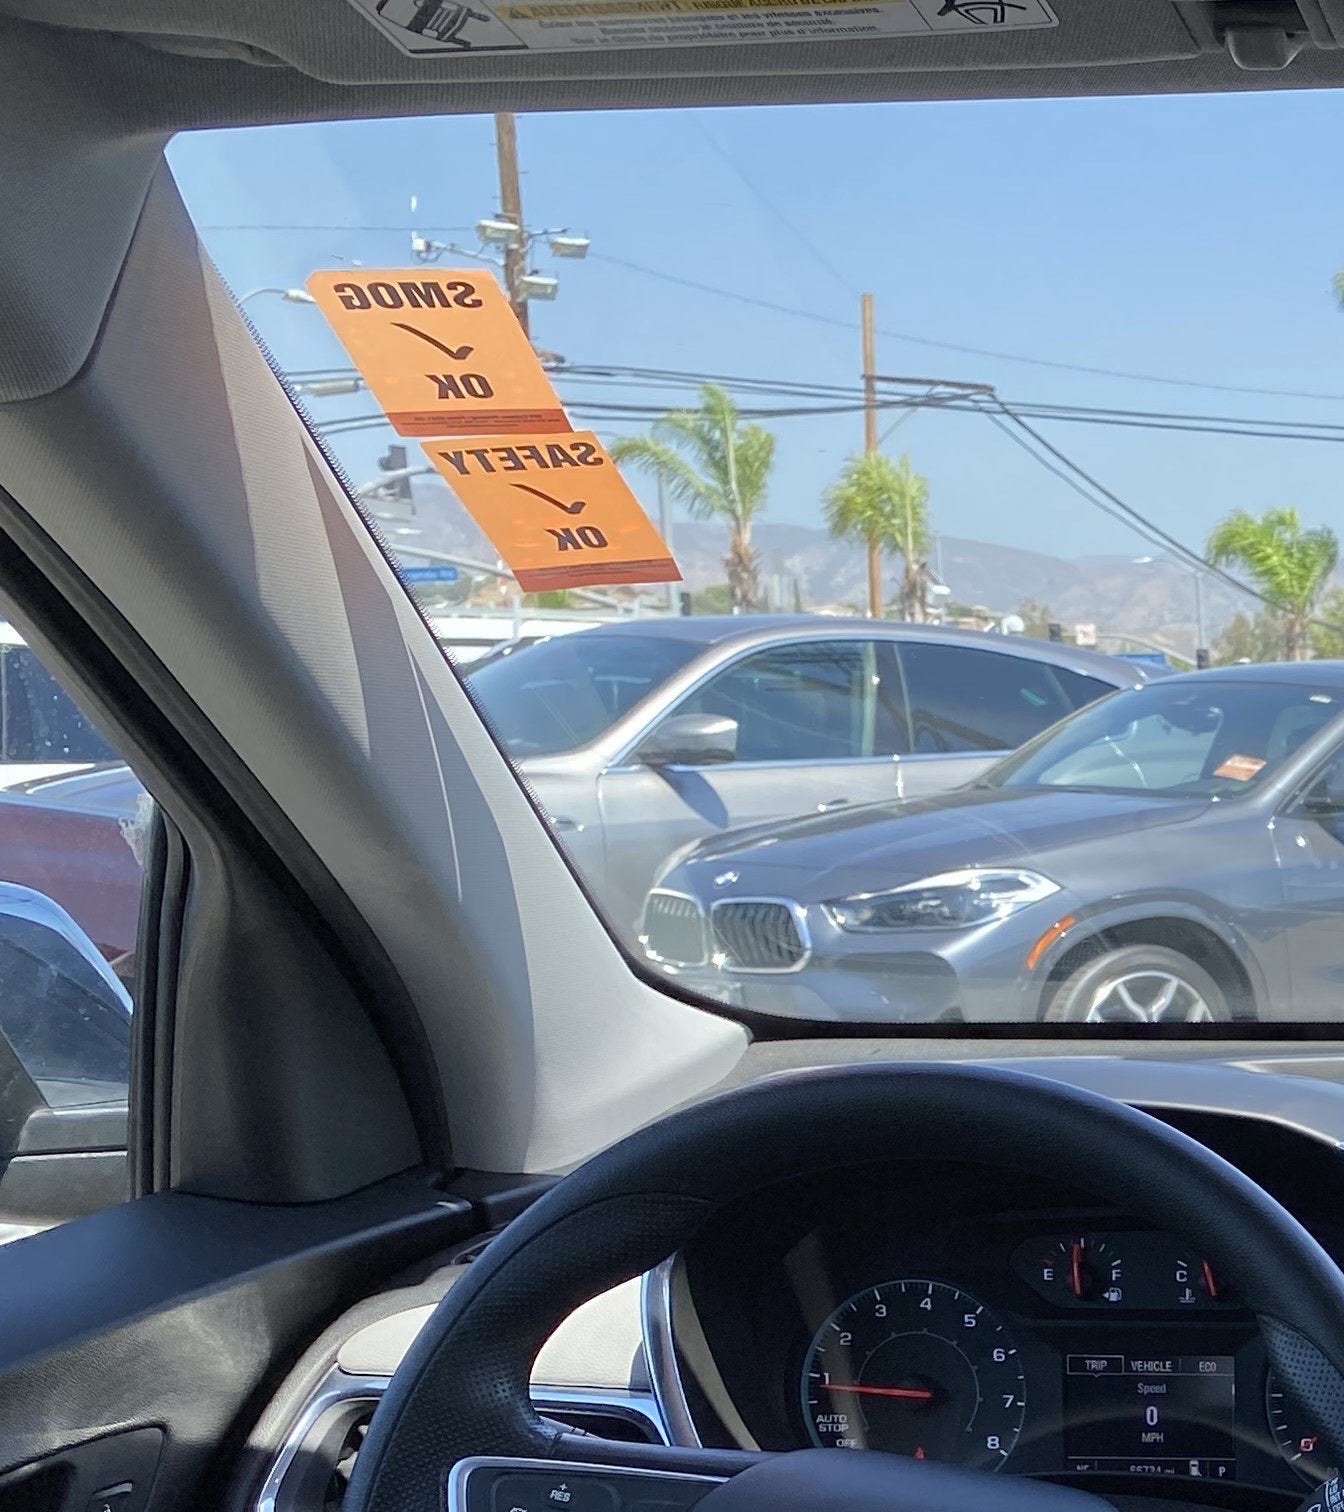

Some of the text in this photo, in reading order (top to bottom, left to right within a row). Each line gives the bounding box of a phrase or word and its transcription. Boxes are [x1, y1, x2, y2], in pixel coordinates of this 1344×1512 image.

[1043, 1268, 1054, 1281] E
[1111, 1269, 1122, 1281] F
[1175, 1270, 1188, 1283] C
[875, 1304, 888, 1318] 3
[919, 1297, 932, 1311] 4
[963, 1313, 977, 1328] 5
[839, 1332, 852, 1346] 2
[992, 1348, 1006, 1362] 6
[1085, 1359, 1217, 1373] TRIP VEHICLE ECO
[1137, 1382, 1167, 1396] Speed
[1001, 1394, 1015, 1408] 7
[815, 1414, 848, 1424] AUTO
[1145, 1405, 1159, 1427] 0
[818, 1423, 850, 1433] STOP
[836, 1438, 858, 1448] OFF
[987, 1435, 1001, 1450] 8
[1141, 1432, 1165, 1444] MPH
[1218, 1466, 1227, 1477] P
[549, 1489, 571, 1503] RES
